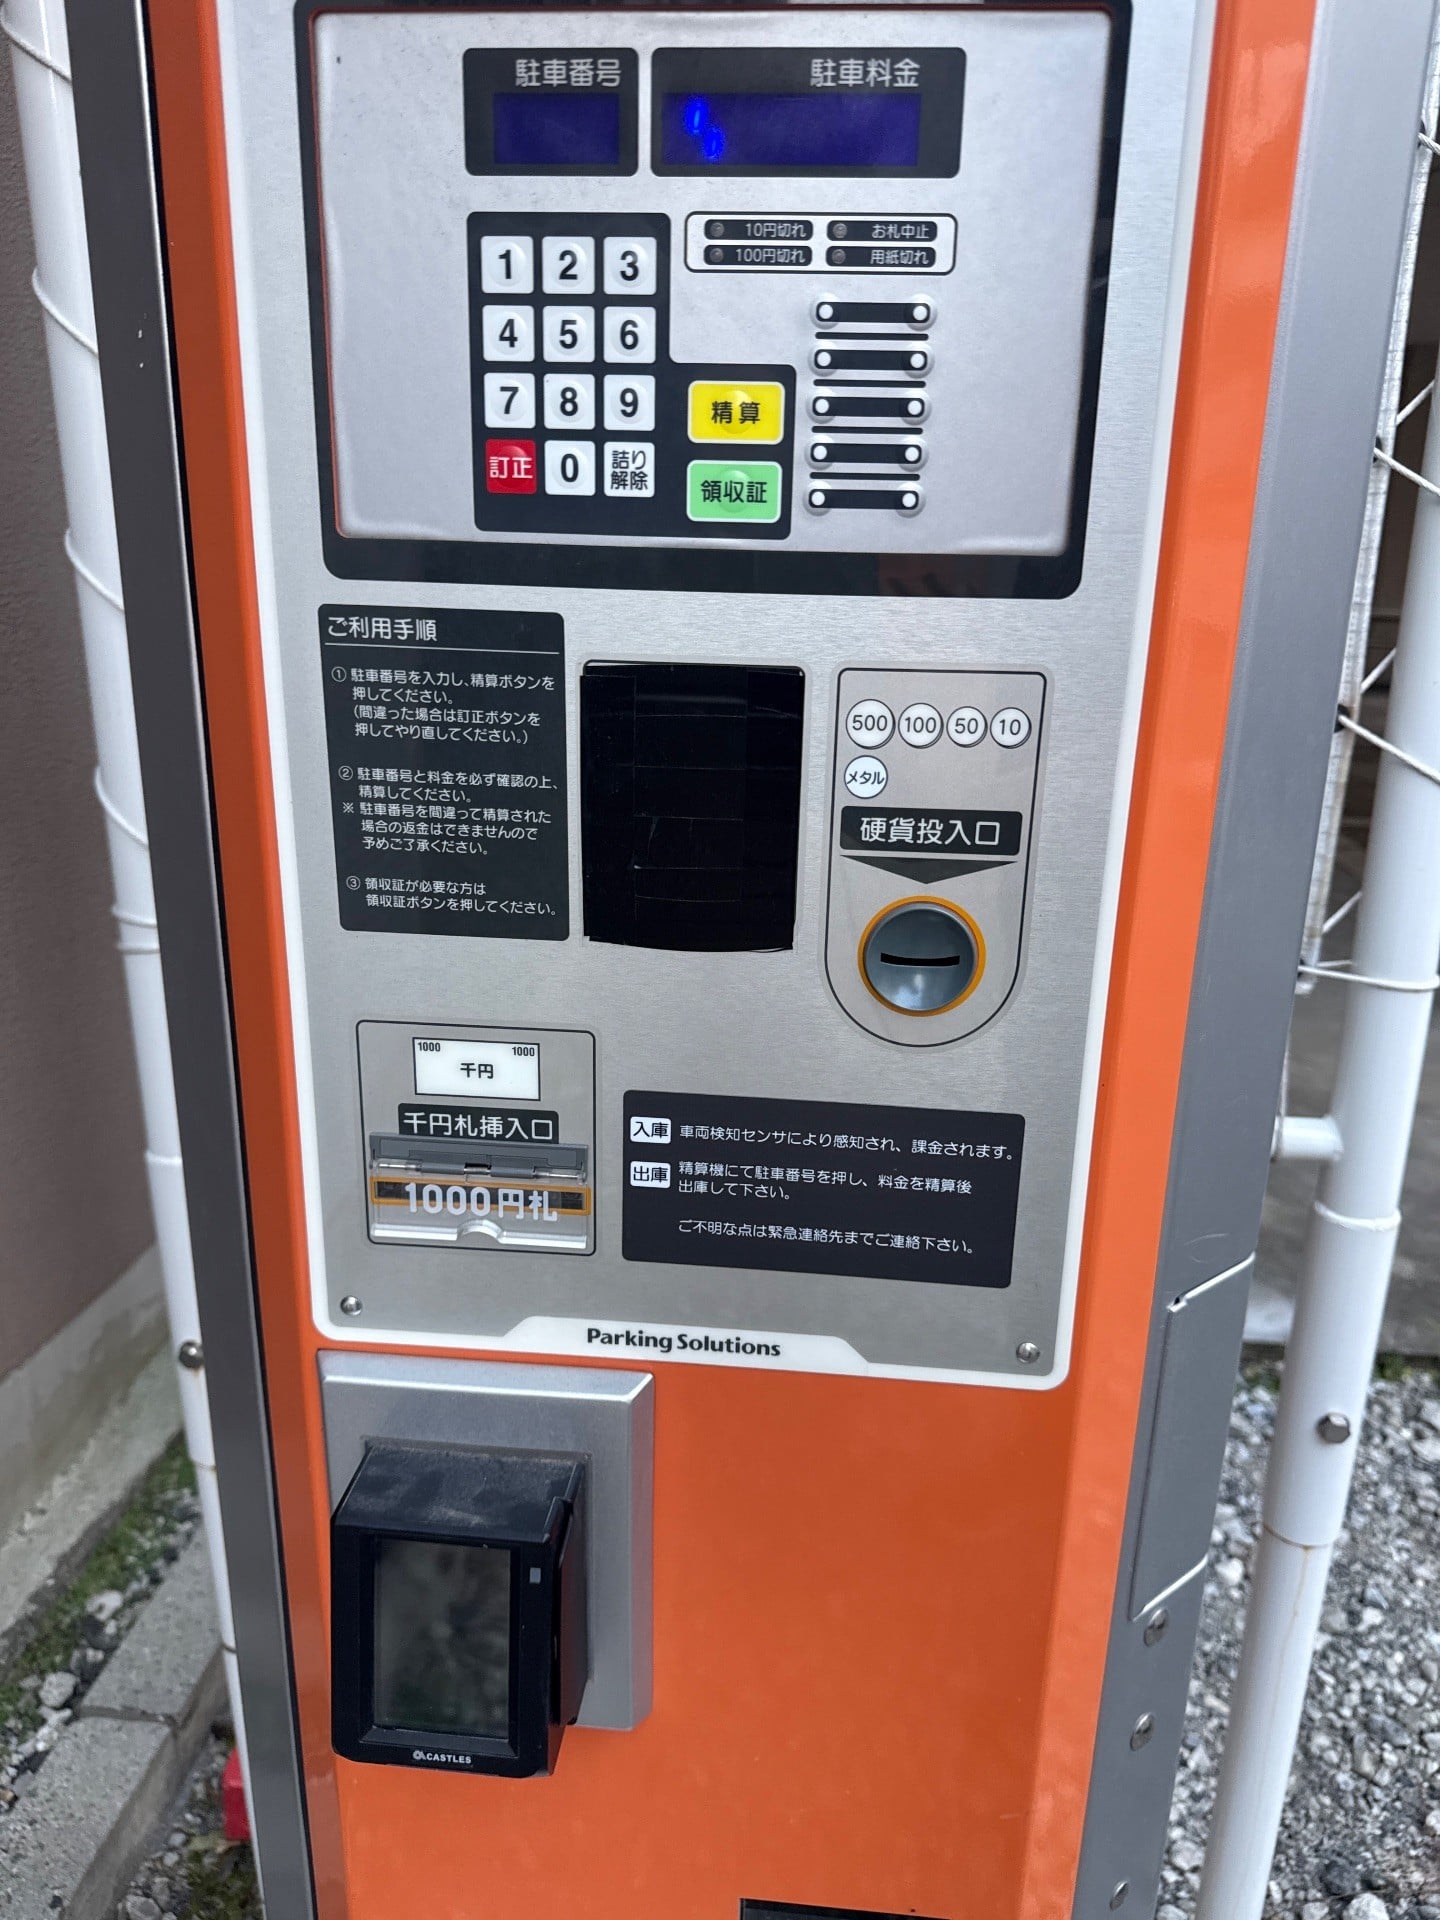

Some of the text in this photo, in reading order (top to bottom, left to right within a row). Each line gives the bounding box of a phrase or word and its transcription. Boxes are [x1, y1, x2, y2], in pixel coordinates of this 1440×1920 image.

[515, 58, 622, 88] 駐車番号
[810, 58, 921, 89] 駐車料金
[745, 222, 807, 239] 10円切れ
[871, 223, 930, 240] お札中止
[498, 249, 512, 280] 1
[559, 249, 578, 280] 2
[620, 250, 639, 281] 3
[735, 248, 806, 265] 100円切れ
[869, 249, 930, 266] 用紙切れ
[499, 319, 518, 348] 4
[559, 319, 578, 349] 5
[619, 319, 639, 350] 6
[499, 386, 519, 414] 7
[559, 386, 578, 417] 8
[619, 387, 639, 418] 9
[711, 401, 761, 425] 精算
[489, 456, 533, 479] 訂正
[560, 453, 579, 483] 0
[611, 450, 647, 470] 詰り
[610, 470, 648, 491] 解除
[700, 480, 767, 504] 領収証
[327, 616, 437, 642] ご利用手順
[352, 686, 454, 704] 押してください。
[852, 714, 888, 732] 500
[904, 717, 937, 734] 100
[954, 718, 979, 735] 50
[999, 719, 1021, 736] 10
[846, 770, 885, 785] メタル
[860, 817, 1000, 846] 硬貨投入口
[418, 1042, 441, 1052] 1000
[512, 1046, 535, 1057] 1000
[460, 1063, 494, 1079] 千円
[403, 1112, 553, 1140] 千円札挿入口
[633, 1120, 669, 1140] 入庫
[632, 1165, 669, 1184] 出庫
[405, 1182, 558, 1222] 1000円札
[678, 1181, 790, 1200] 出庫して下さい。
[587, 1328, 673, 1353] Parking
[426, 1752, 472, 1764] CASTLES
